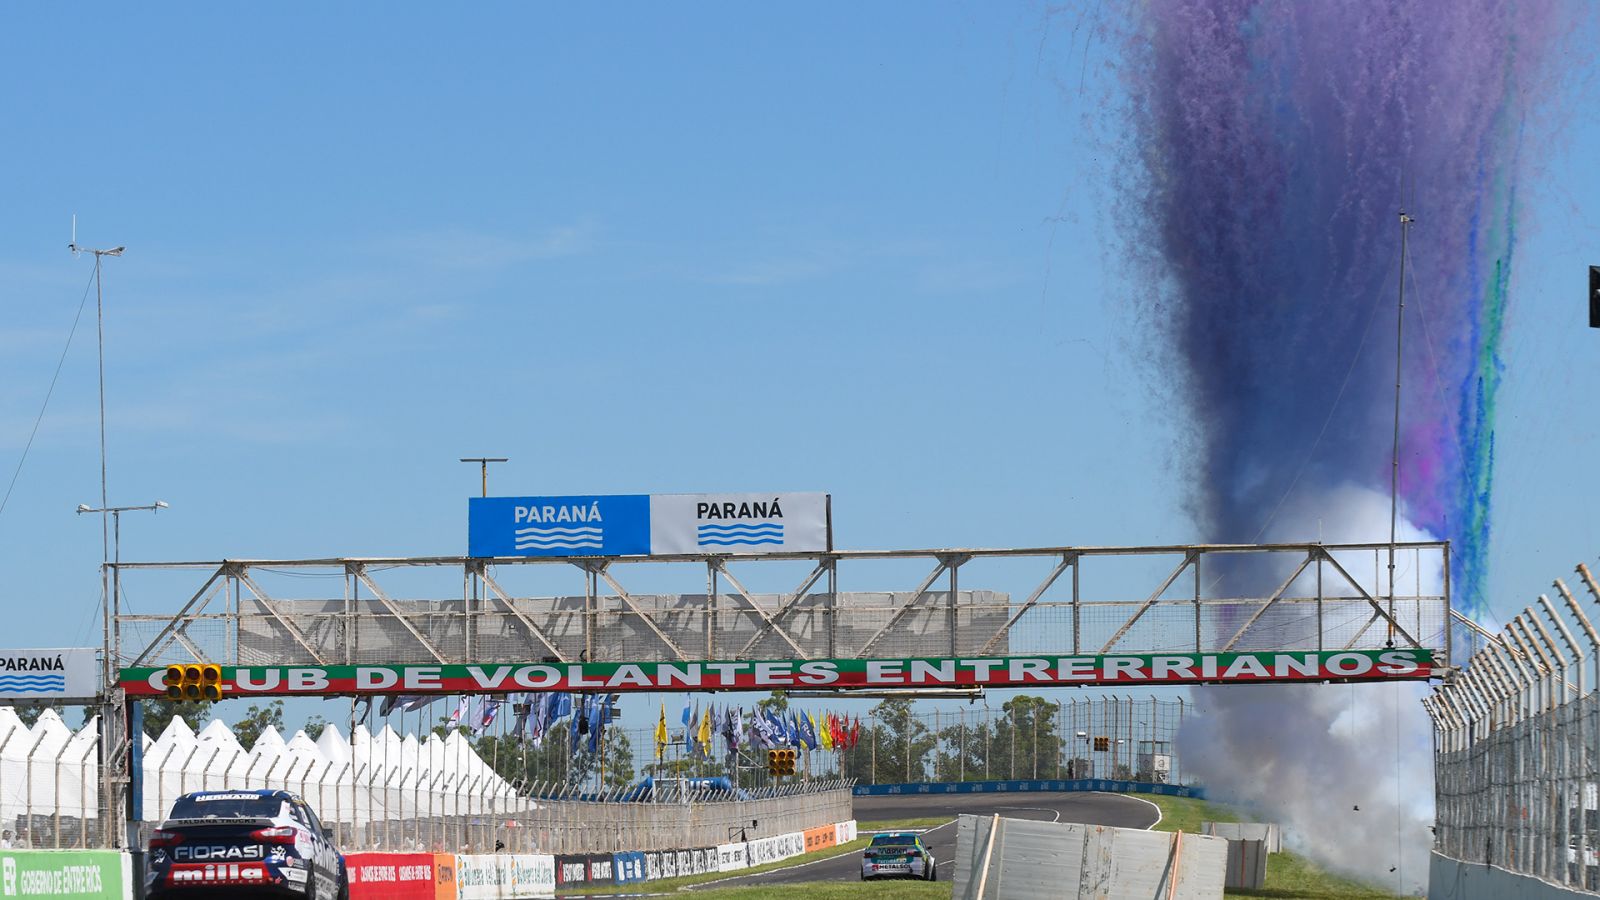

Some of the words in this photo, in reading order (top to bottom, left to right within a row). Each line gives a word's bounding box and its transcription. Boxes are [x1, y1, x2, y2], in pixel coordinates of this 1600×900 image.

[514, 501, 603, 523] PARANÁ
[697, 498, 784, 519] PARANÁ
[356, 667, 443, 689] DE
[466, 662, 840, 688] VOLANTES
[866, 651, 1418, 683] ENTRERRIANOS
[174, 844, 264, 860] FIORASI
[21, 870, 53, 895] GOBIERNO
[54, 871, 62, 894] DE
[63, 865, 85, 894] ENTRE
[173, 864, 263, 881] milla
